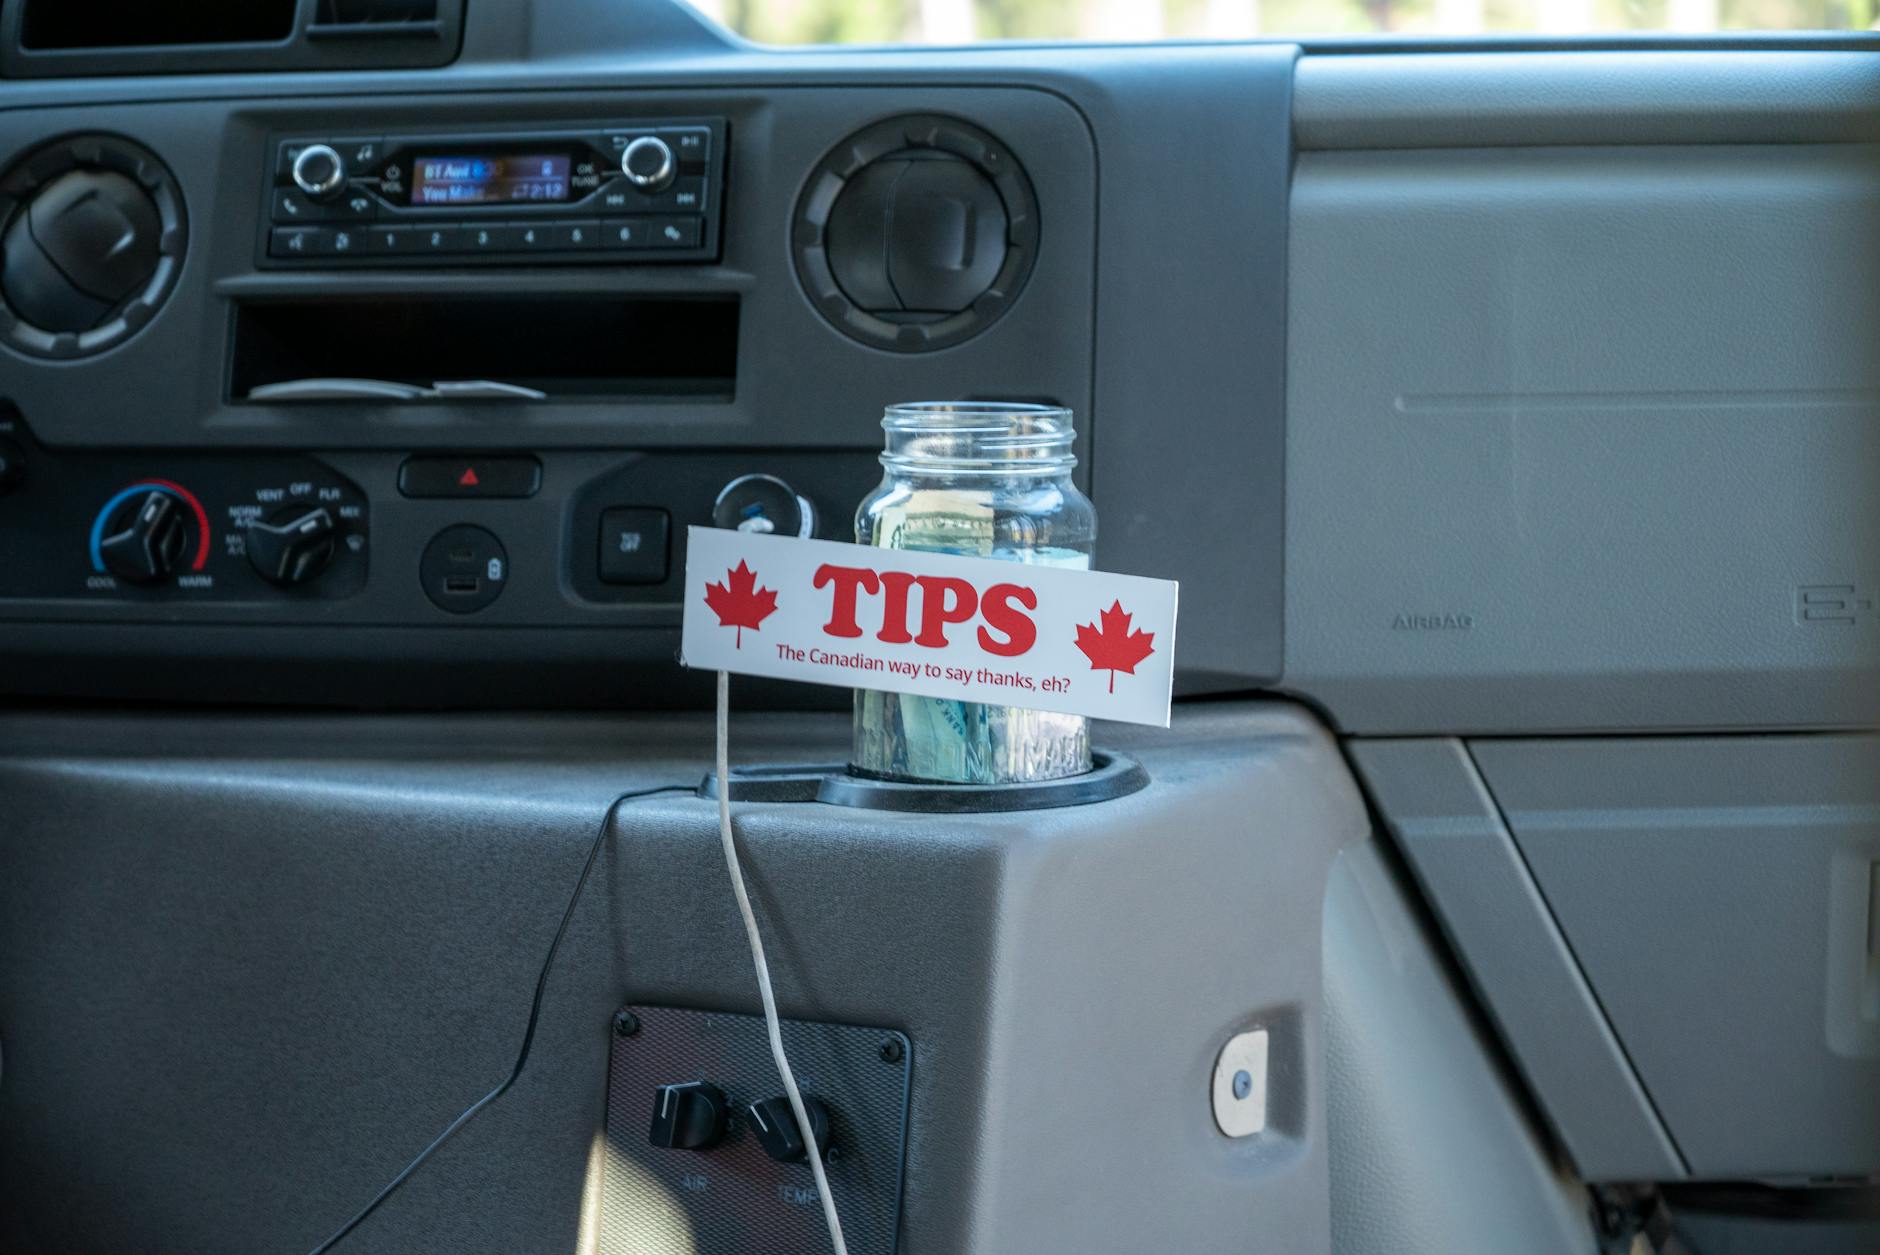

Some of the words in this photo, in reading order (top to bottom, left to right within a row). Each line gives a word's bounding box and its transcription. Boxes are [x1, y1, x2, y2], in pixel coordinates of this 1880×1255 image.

[256, 488, 284, 501] VENT
[289, 482, 313, 495] OFF
[228, 505, 263, 518] NORM
[87, 575, 116, 589] COOL
[178, 575, 213, 588] WARM
[813, 563, 1038, 657] TIPS
[1392, 613, 1473, 631] AIRBAG
[776, 643, 806, 662] The
[809, 648, 884, 672] Canadian
[888, 659, 921, 680] way
[925, 662, 942, 678] to
[945, 667, 973, 686] say
[977, 668, 1037, 692] thanks,
[1041, 676, 1071, 693] eh?
